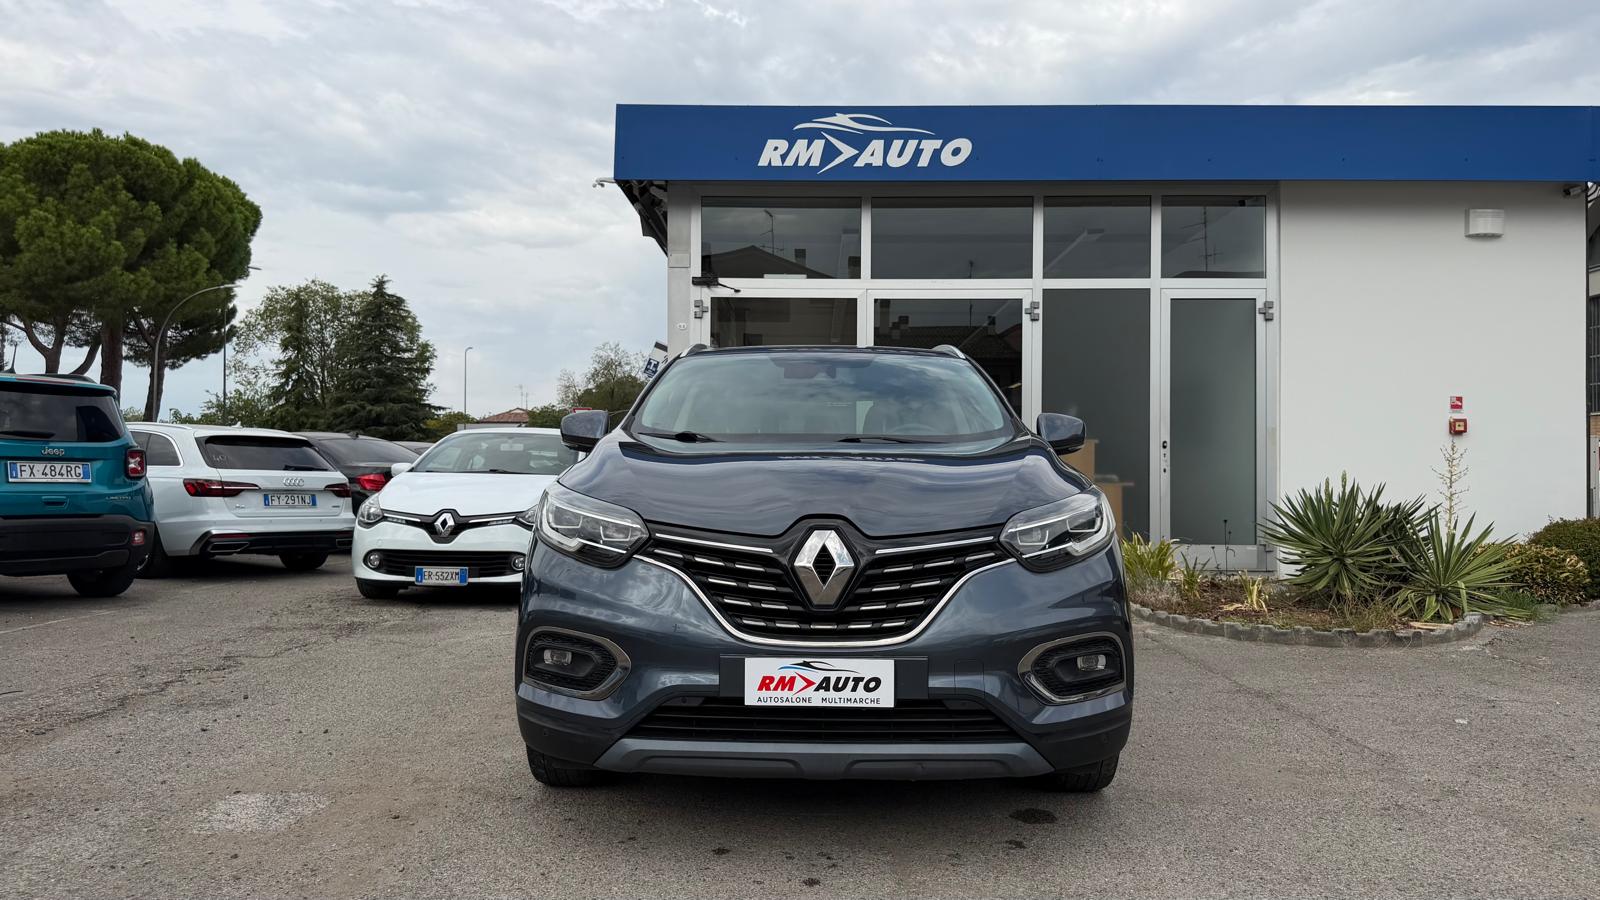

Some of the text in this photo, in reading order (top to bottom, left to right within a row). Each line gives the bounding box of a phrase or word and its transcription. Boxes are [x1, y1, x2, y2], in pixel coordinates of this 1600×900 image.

[758, 138, 973, 168] RM AUTO
[42, 446, 65, 456] Jeep
[20, 465, 81, 477] FX 484RG
[270, 496, 312, 505] FY 291NJ
[757, 675, 882, 693] RM AUTO
[757, 696, 881, 705] AUTOSALONE MULTIMARCHE
